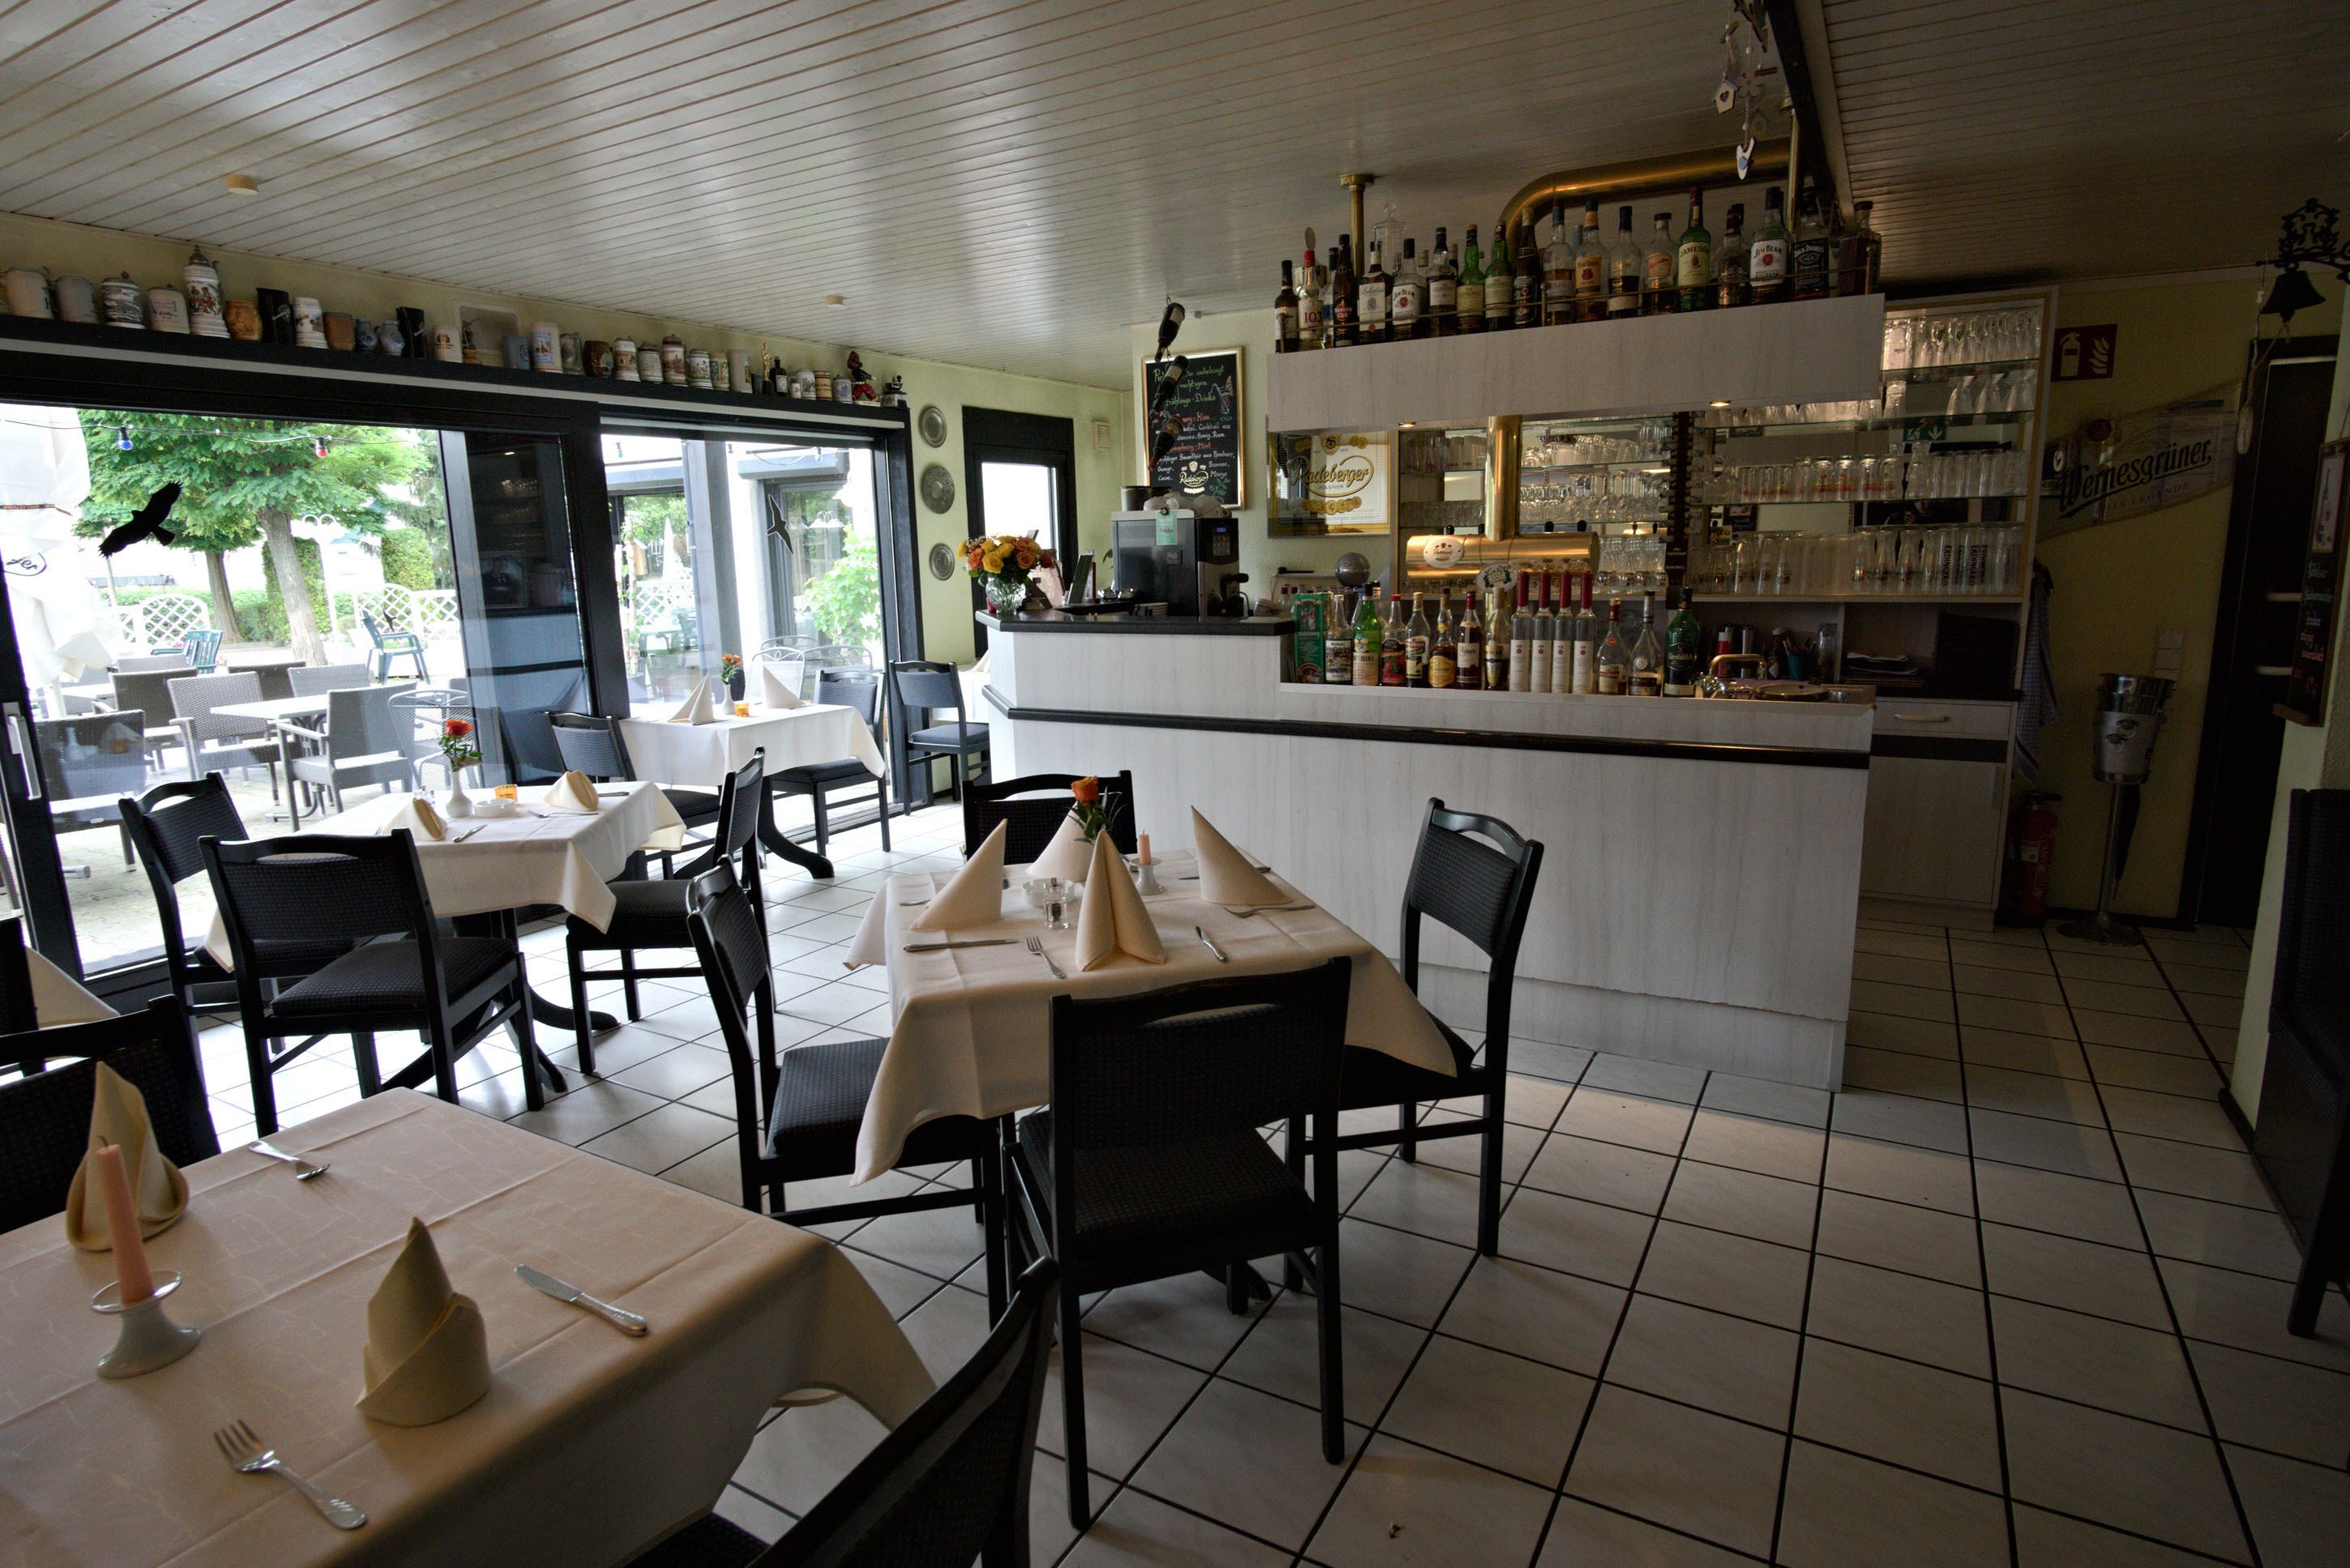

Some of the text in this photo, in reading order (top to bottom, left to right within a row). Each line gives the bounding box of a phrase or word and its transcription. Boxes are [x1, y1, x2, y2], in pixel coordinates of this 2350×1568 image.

[1680, 246, 1709, 258] JAMESON
[1304, 311, 1322, 324] 103
[1290, 455, 1369, 488] Radeberger
[2057, 439, 2212, 513] Wernesgrüner
